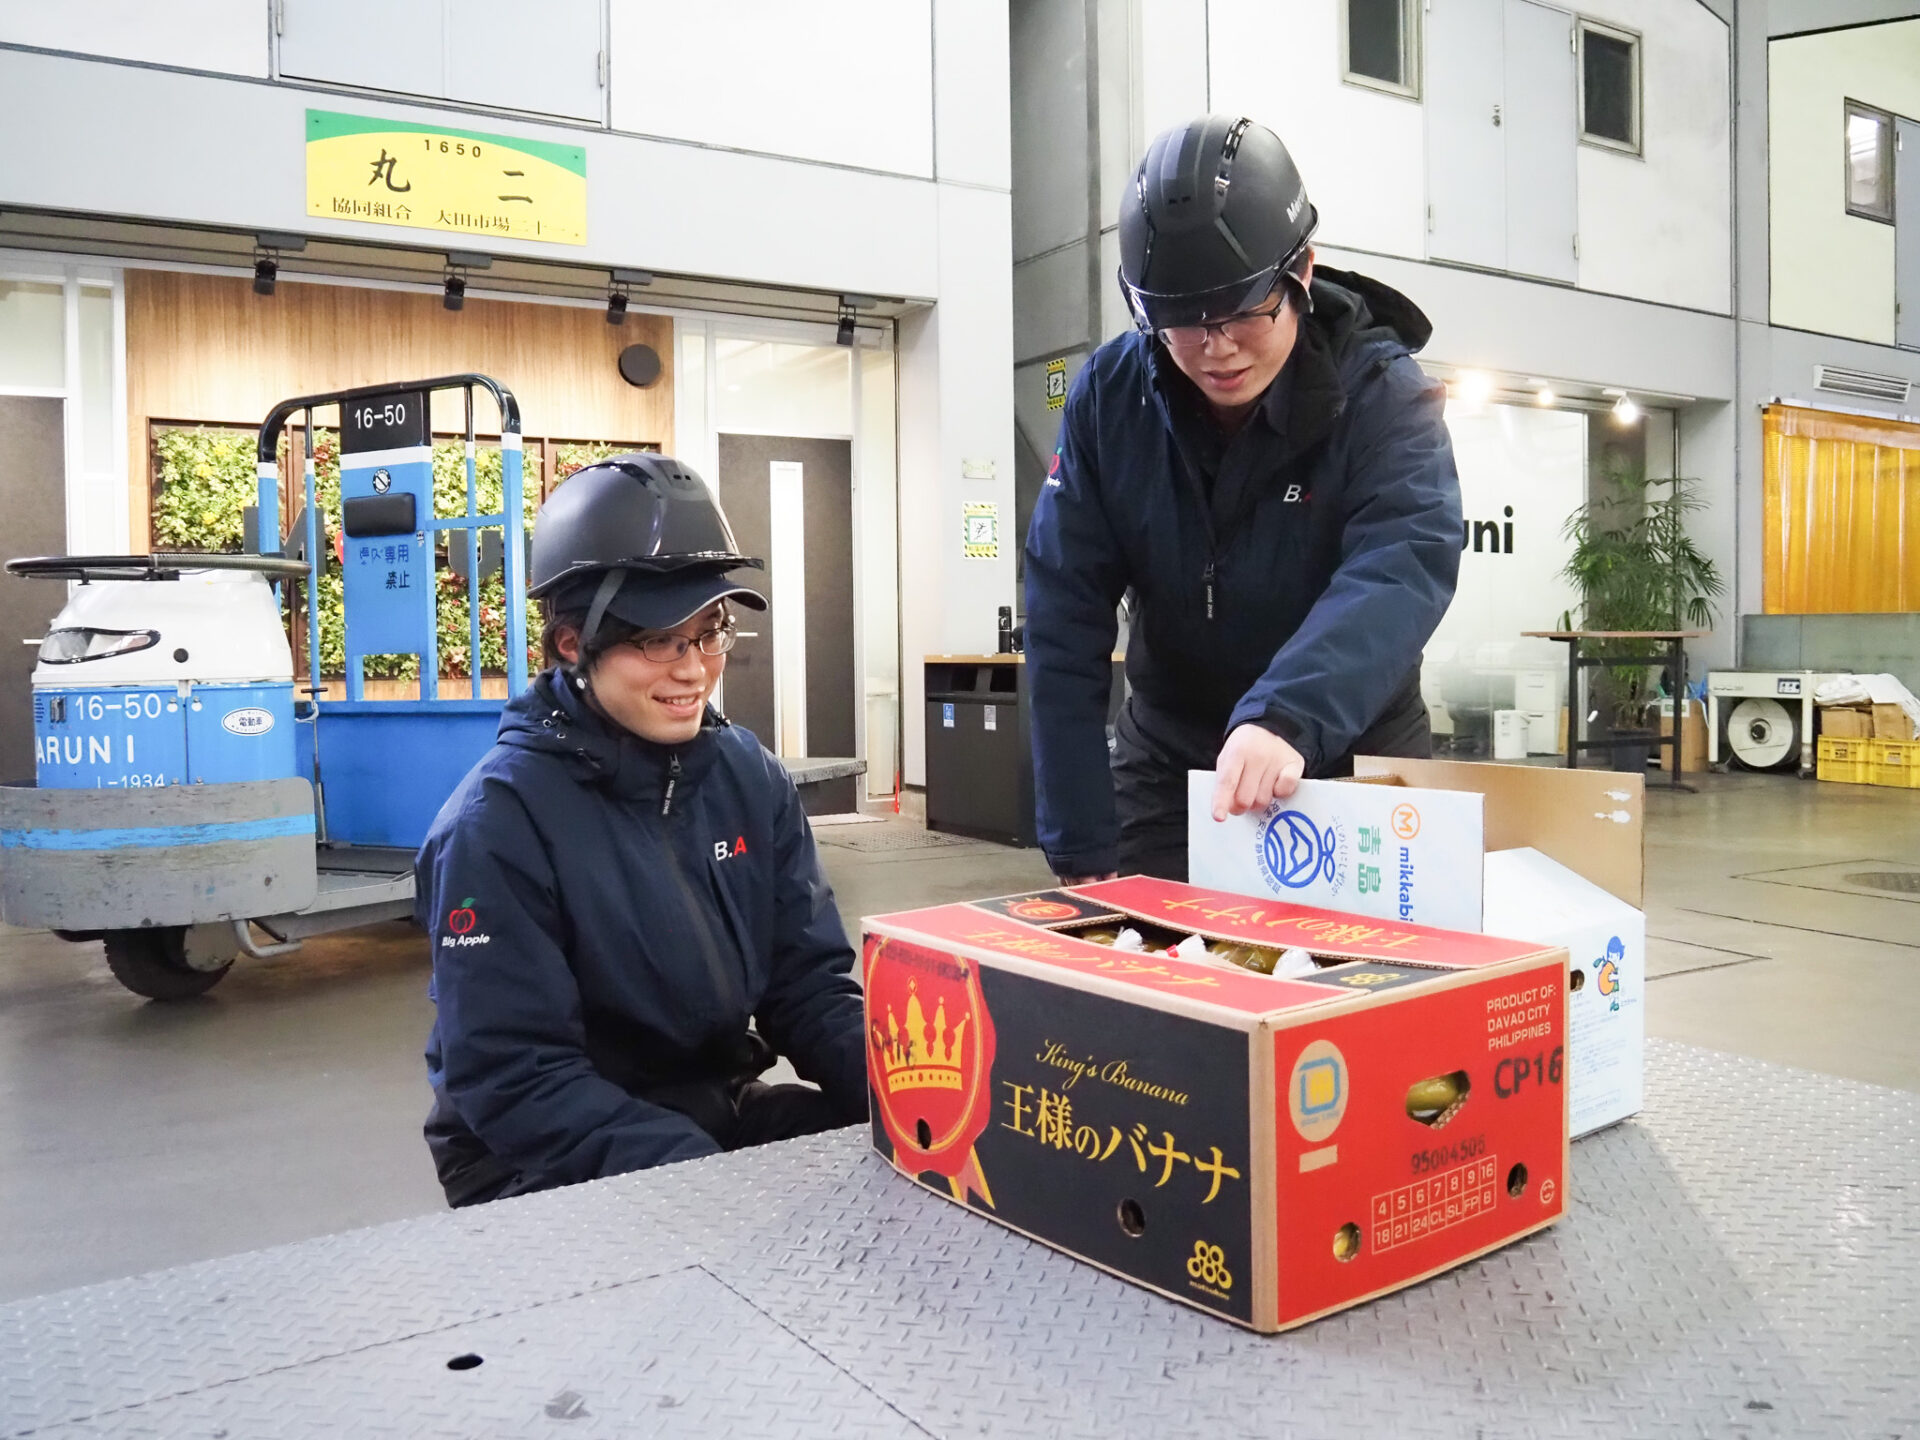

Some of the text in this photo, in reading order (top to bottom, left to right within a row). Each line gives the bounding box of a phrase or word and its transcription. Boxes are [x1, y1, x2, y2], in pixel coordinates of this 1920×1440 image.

[424, 138, 482, 158] 1650
[367, 148, 533, 204] 丸 二
[332, 196, 412, 221] 協同組合
[354, 403, 406, 430] 16-50
[386, 571, 411, 590] 禁止
[75, 693, 162, 721] 16-50
[713, 836, 748, 860] B.A
[1357, 827, 1382, 895] 青島
[1399, 846, 1414, 923] mikkabi
[441, 933, 490, 948] Big Apple
[1486, 984, 1556, 1013] PRODUCT OF:
[1487, 1003, 1550, 1033] DAVAO CITY
[1488, 1022, 1552, 1052] PHILIPPINES
[1036, 1038, 1190, 1106] King's Banana
[1494, 1046, 1564, 1099] CP16
[1000, 1080, 1241, 1204] 王様のバナナ
[1378, 1163, 1494, 1216] 4 5 6 7 8 9 16
[1376, 1191, 1491, 1245] 18 21 24 CL SL FP B
